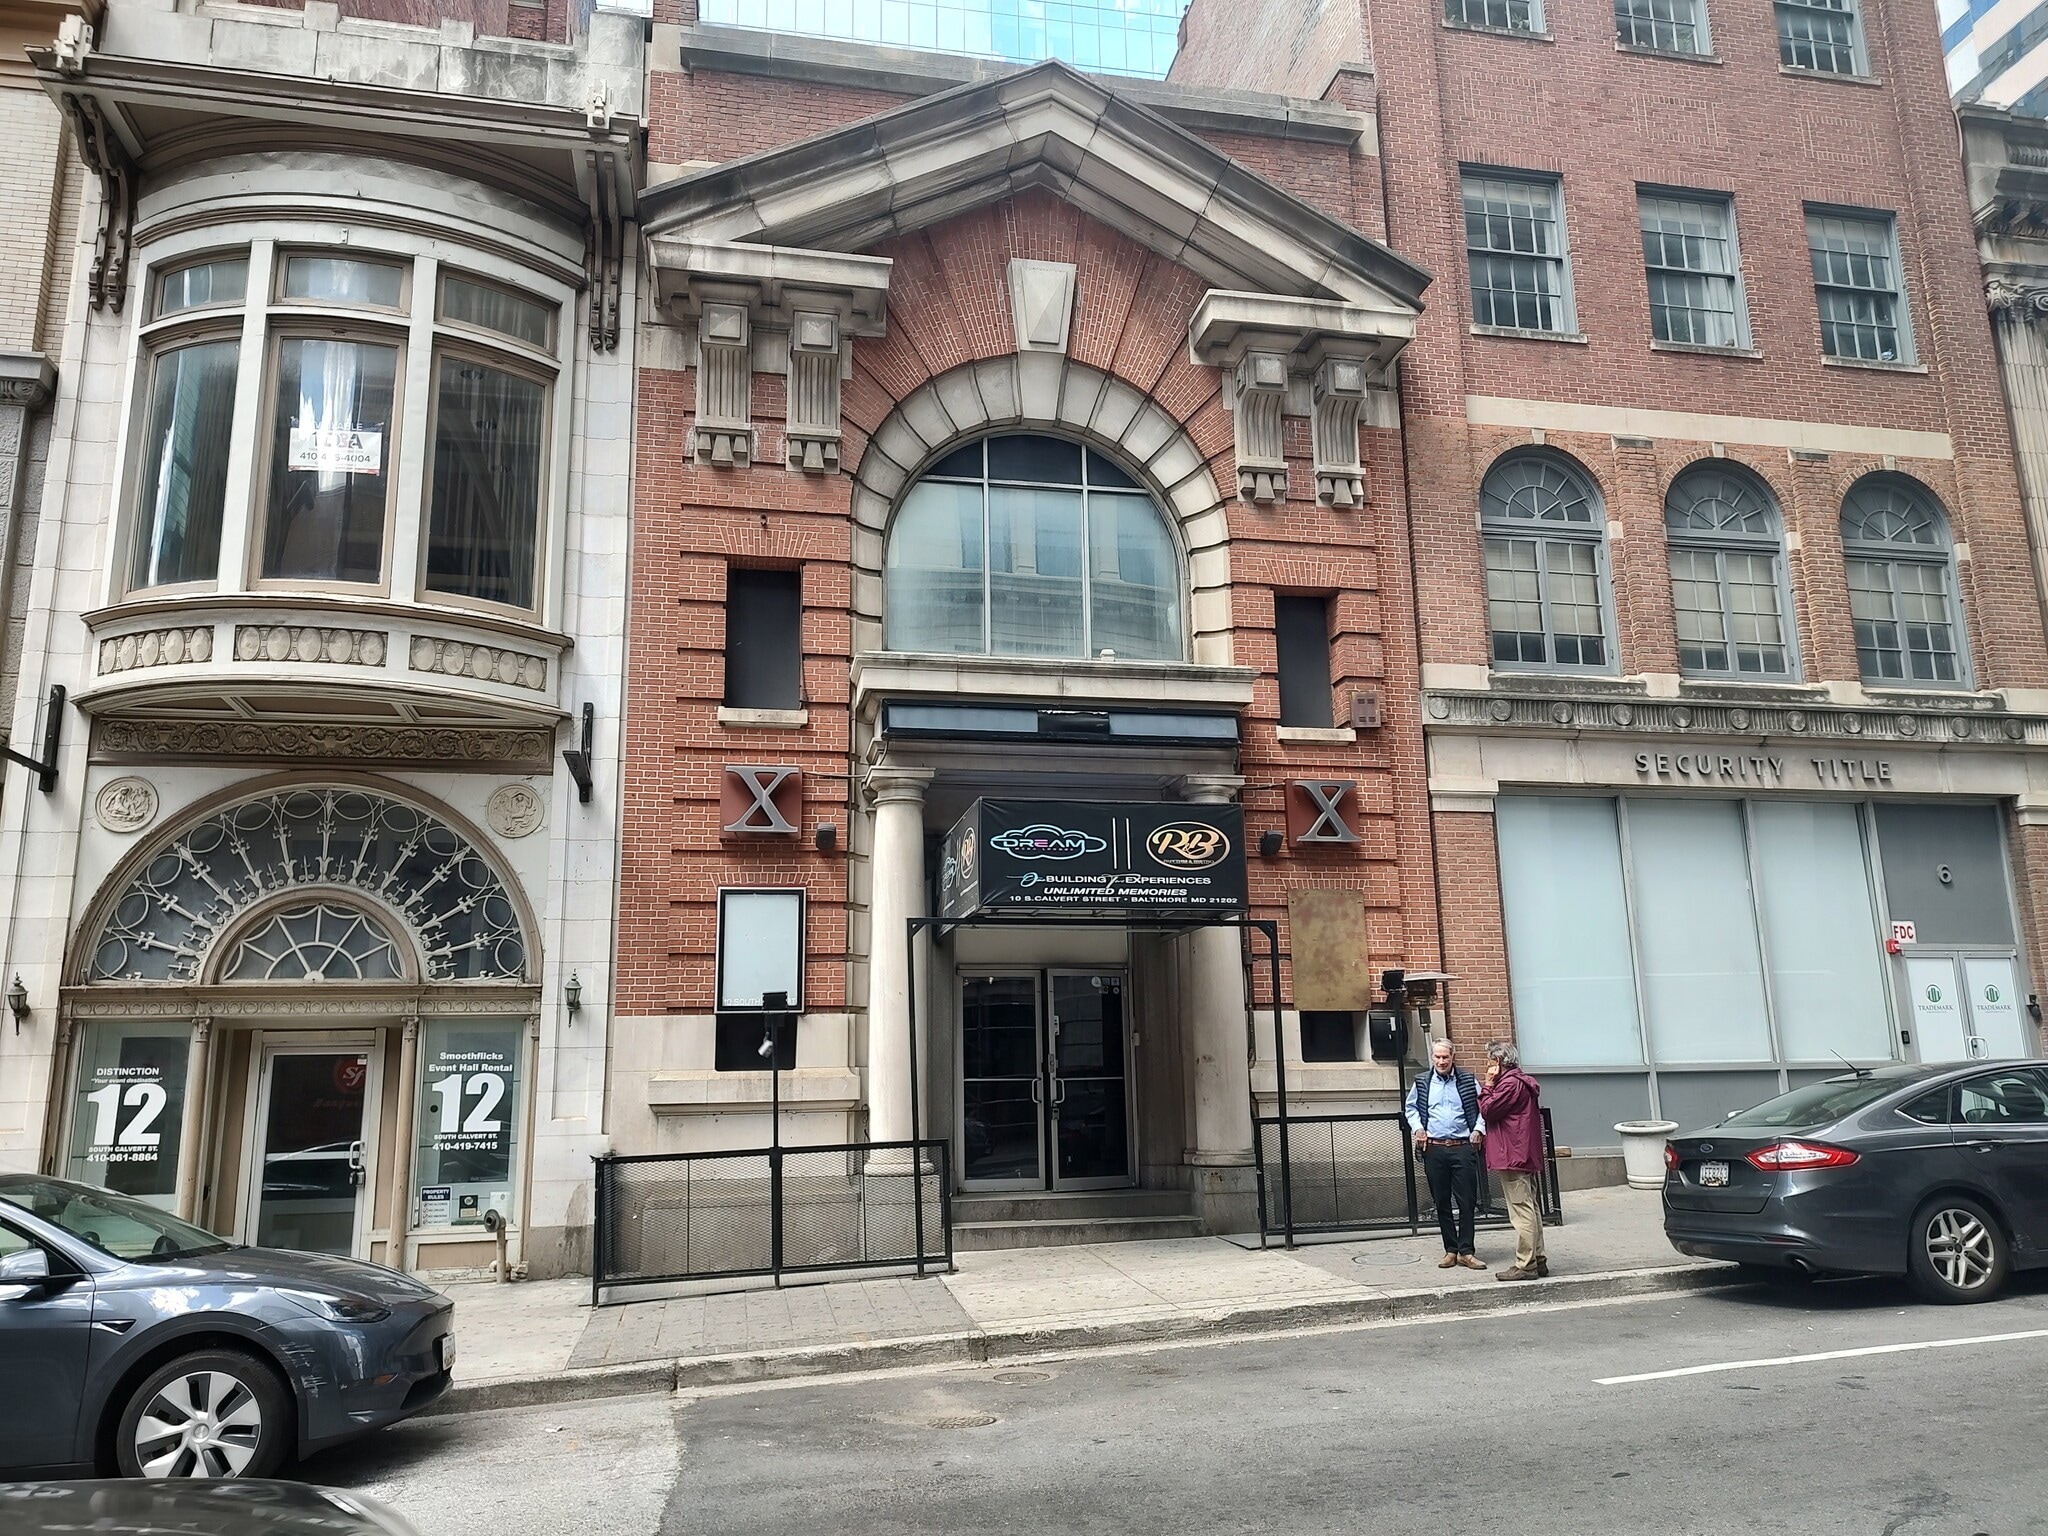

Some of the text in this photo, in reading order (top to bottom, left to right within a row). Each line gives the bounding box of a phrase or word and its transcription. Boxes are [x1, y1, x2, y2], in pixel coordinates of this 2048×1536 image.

[1635, 751, 1893, 780] SECURITY TITLE
[723, 765, 800, 833] X
[1292, 780, 1363, 843] X
[1003, 838, 1085, 848] DREAM
[1152, 829, 1222, 859] R&B
[1936, 864, 1951, 882] 6
[1046, 875, 1107, 883] BUILDING
[1125, 876, 1212, 885] EXPERIENCES
[1043, 887, 1188, 896] UNLIMITED MEMORIES
[1131, 896, 1188, 904] BALTIMORE
[1893, 925, 1914, 939] FDC
[439, 1052, 504, 1060] Smoothflicks
[96, 1067, 160, 1076] DISTINCTION
[428, 1063, 513, 1072] Event Hall Rental
[432, 1072, 505, 1133] 12
[87, 1083, 167, 1145] 12
[432, 1141, 498, 1151] 410-419-7415
[86, 1152, 158, 1162] 410-961-8864
